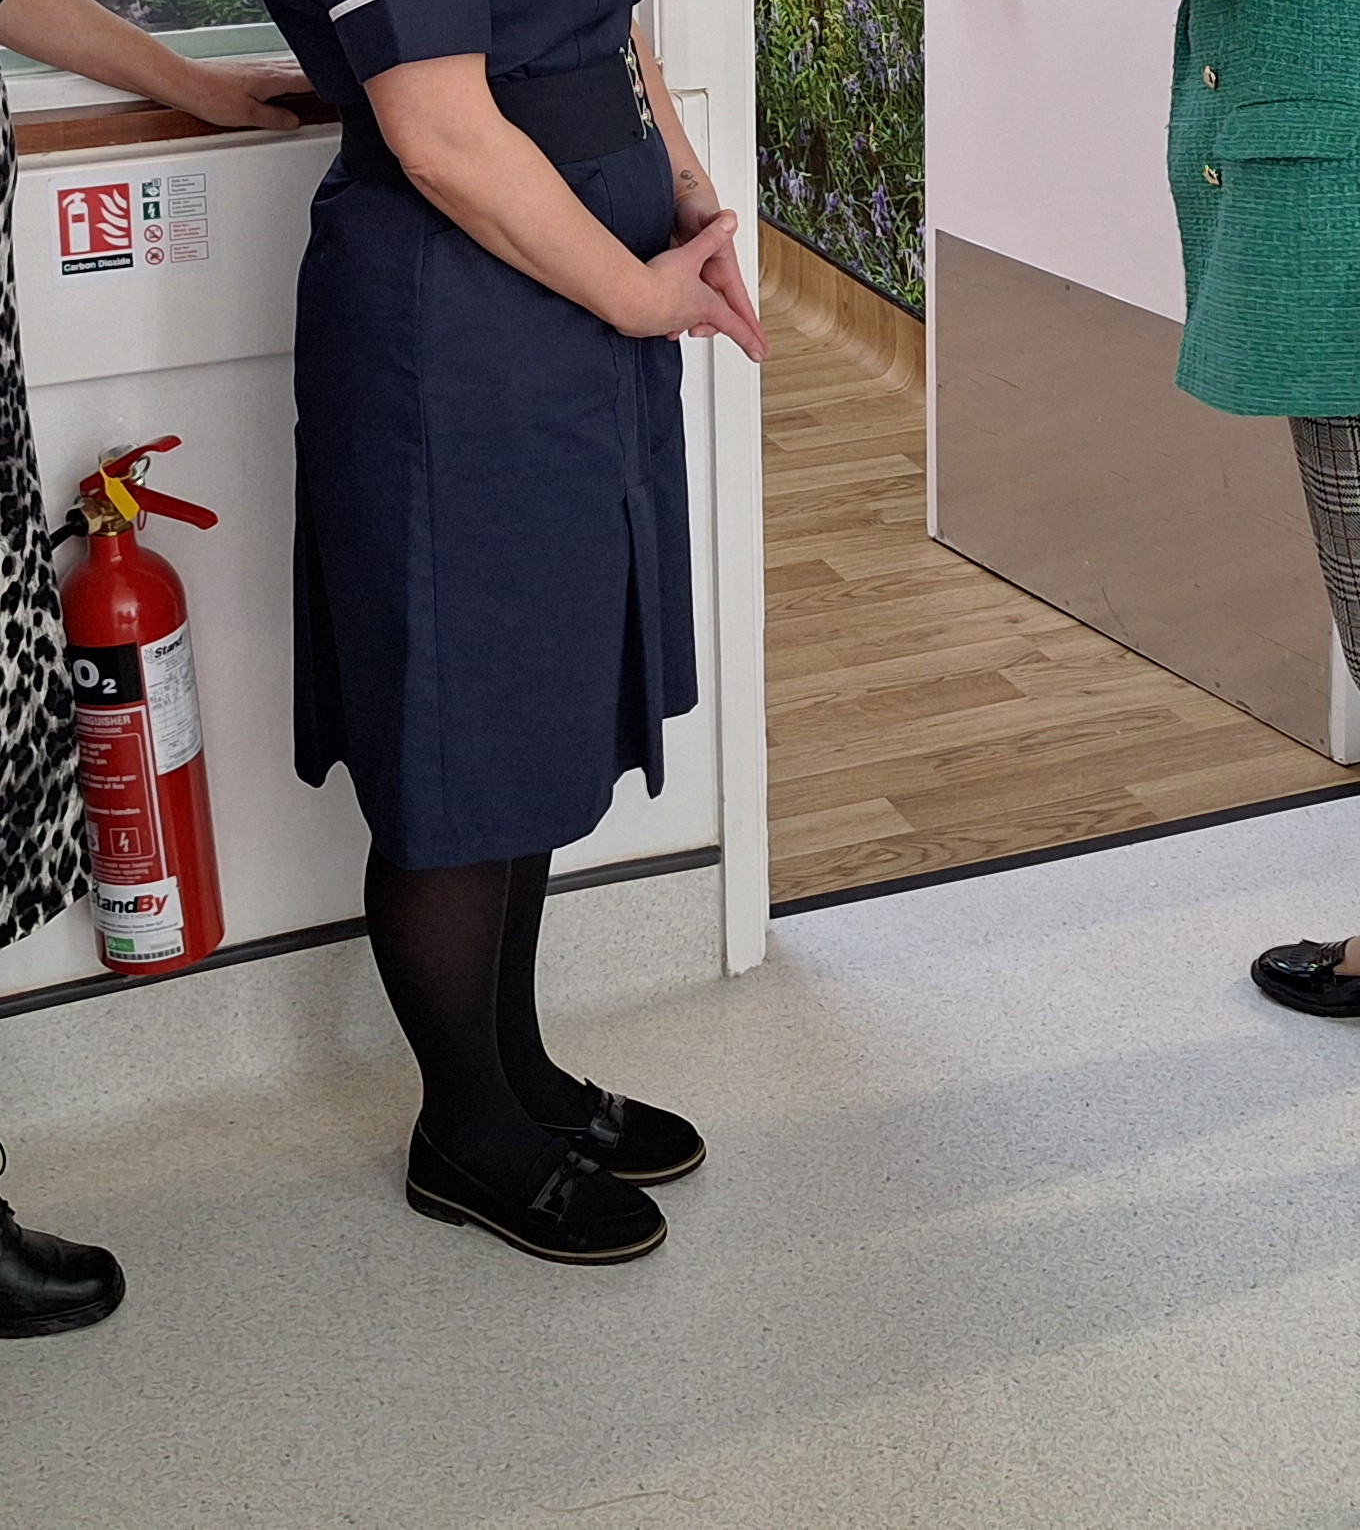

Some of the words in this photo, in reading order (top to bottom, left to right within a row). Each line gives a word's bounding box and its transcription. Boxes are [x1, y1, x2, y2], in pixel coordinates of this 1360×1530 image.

[63, 261, 97, 272] Carbon
[97, 257, 131, 268] Dioxide
[72, 658, 118, 695] O2
